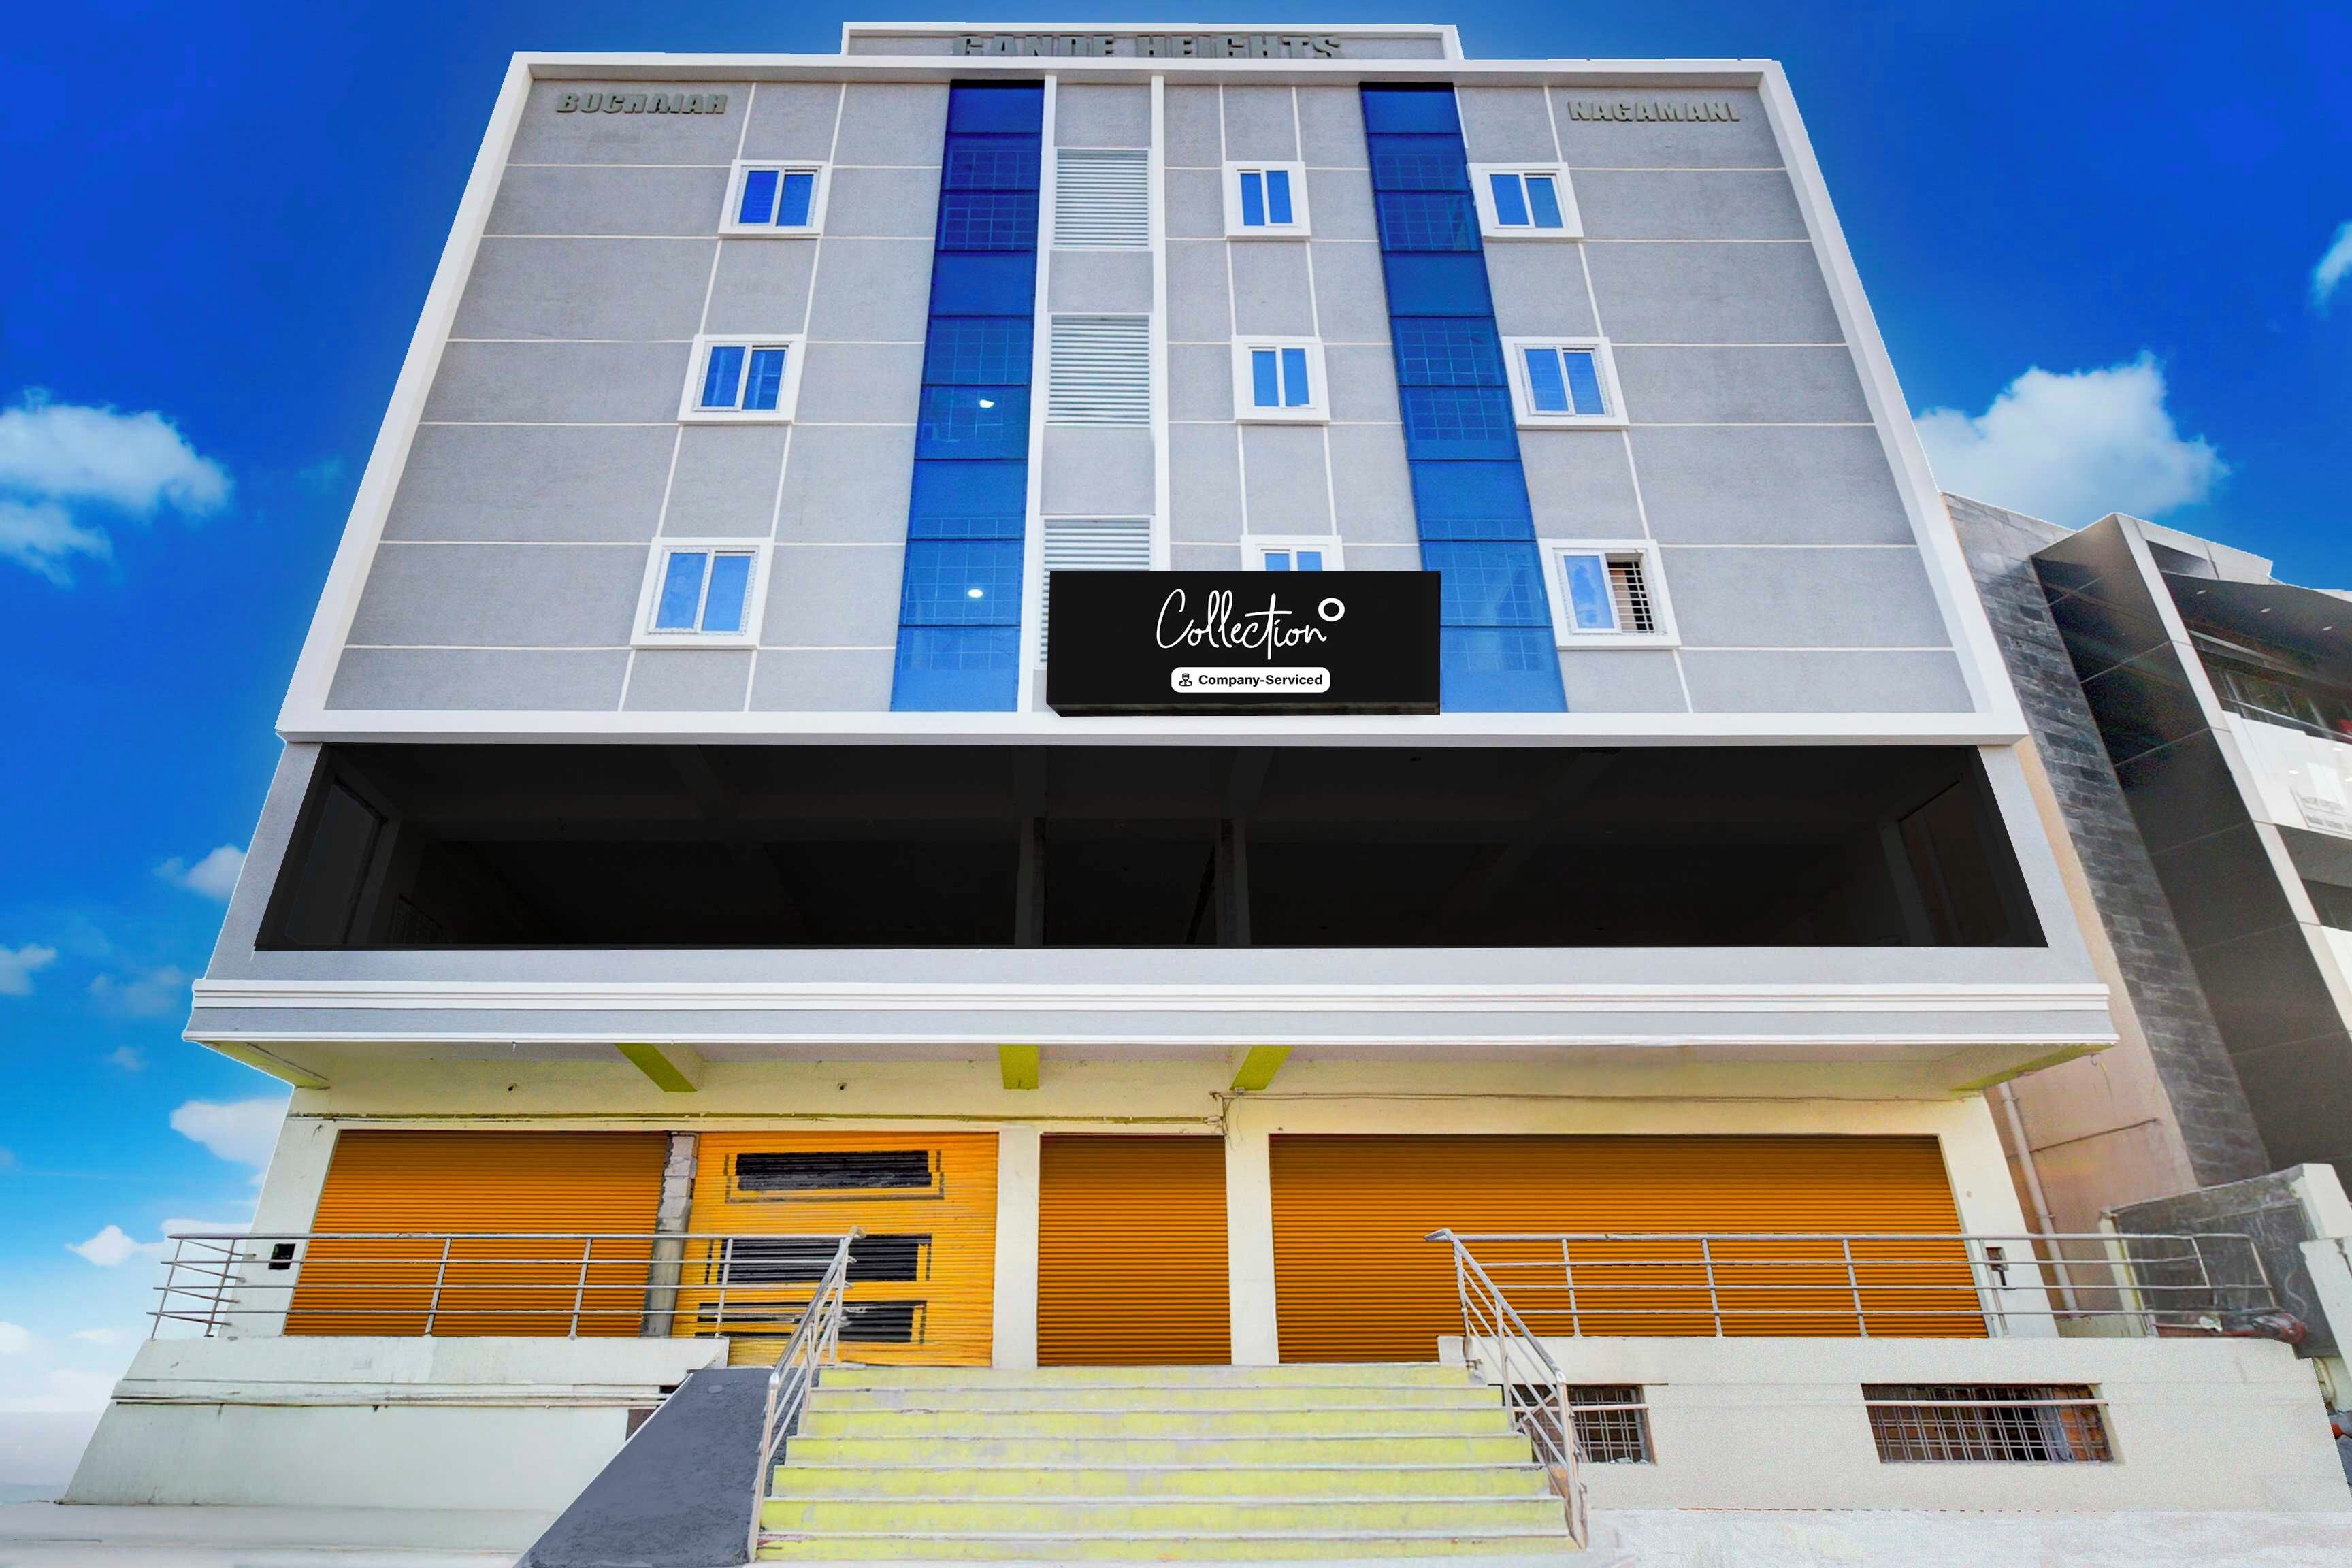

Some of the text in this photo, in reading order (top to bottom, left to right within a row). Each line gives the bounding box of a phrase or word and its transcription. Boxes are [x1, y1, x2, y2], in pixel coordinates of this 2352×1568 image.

[952, 34, 1341, 57] GANDE HEIGHTS
[1567, 101, 1741, 122] NAGAMANI
[1156, 589, 1327, 660] Collection
[1198, 674, 1322, 687] Company-Serviced
